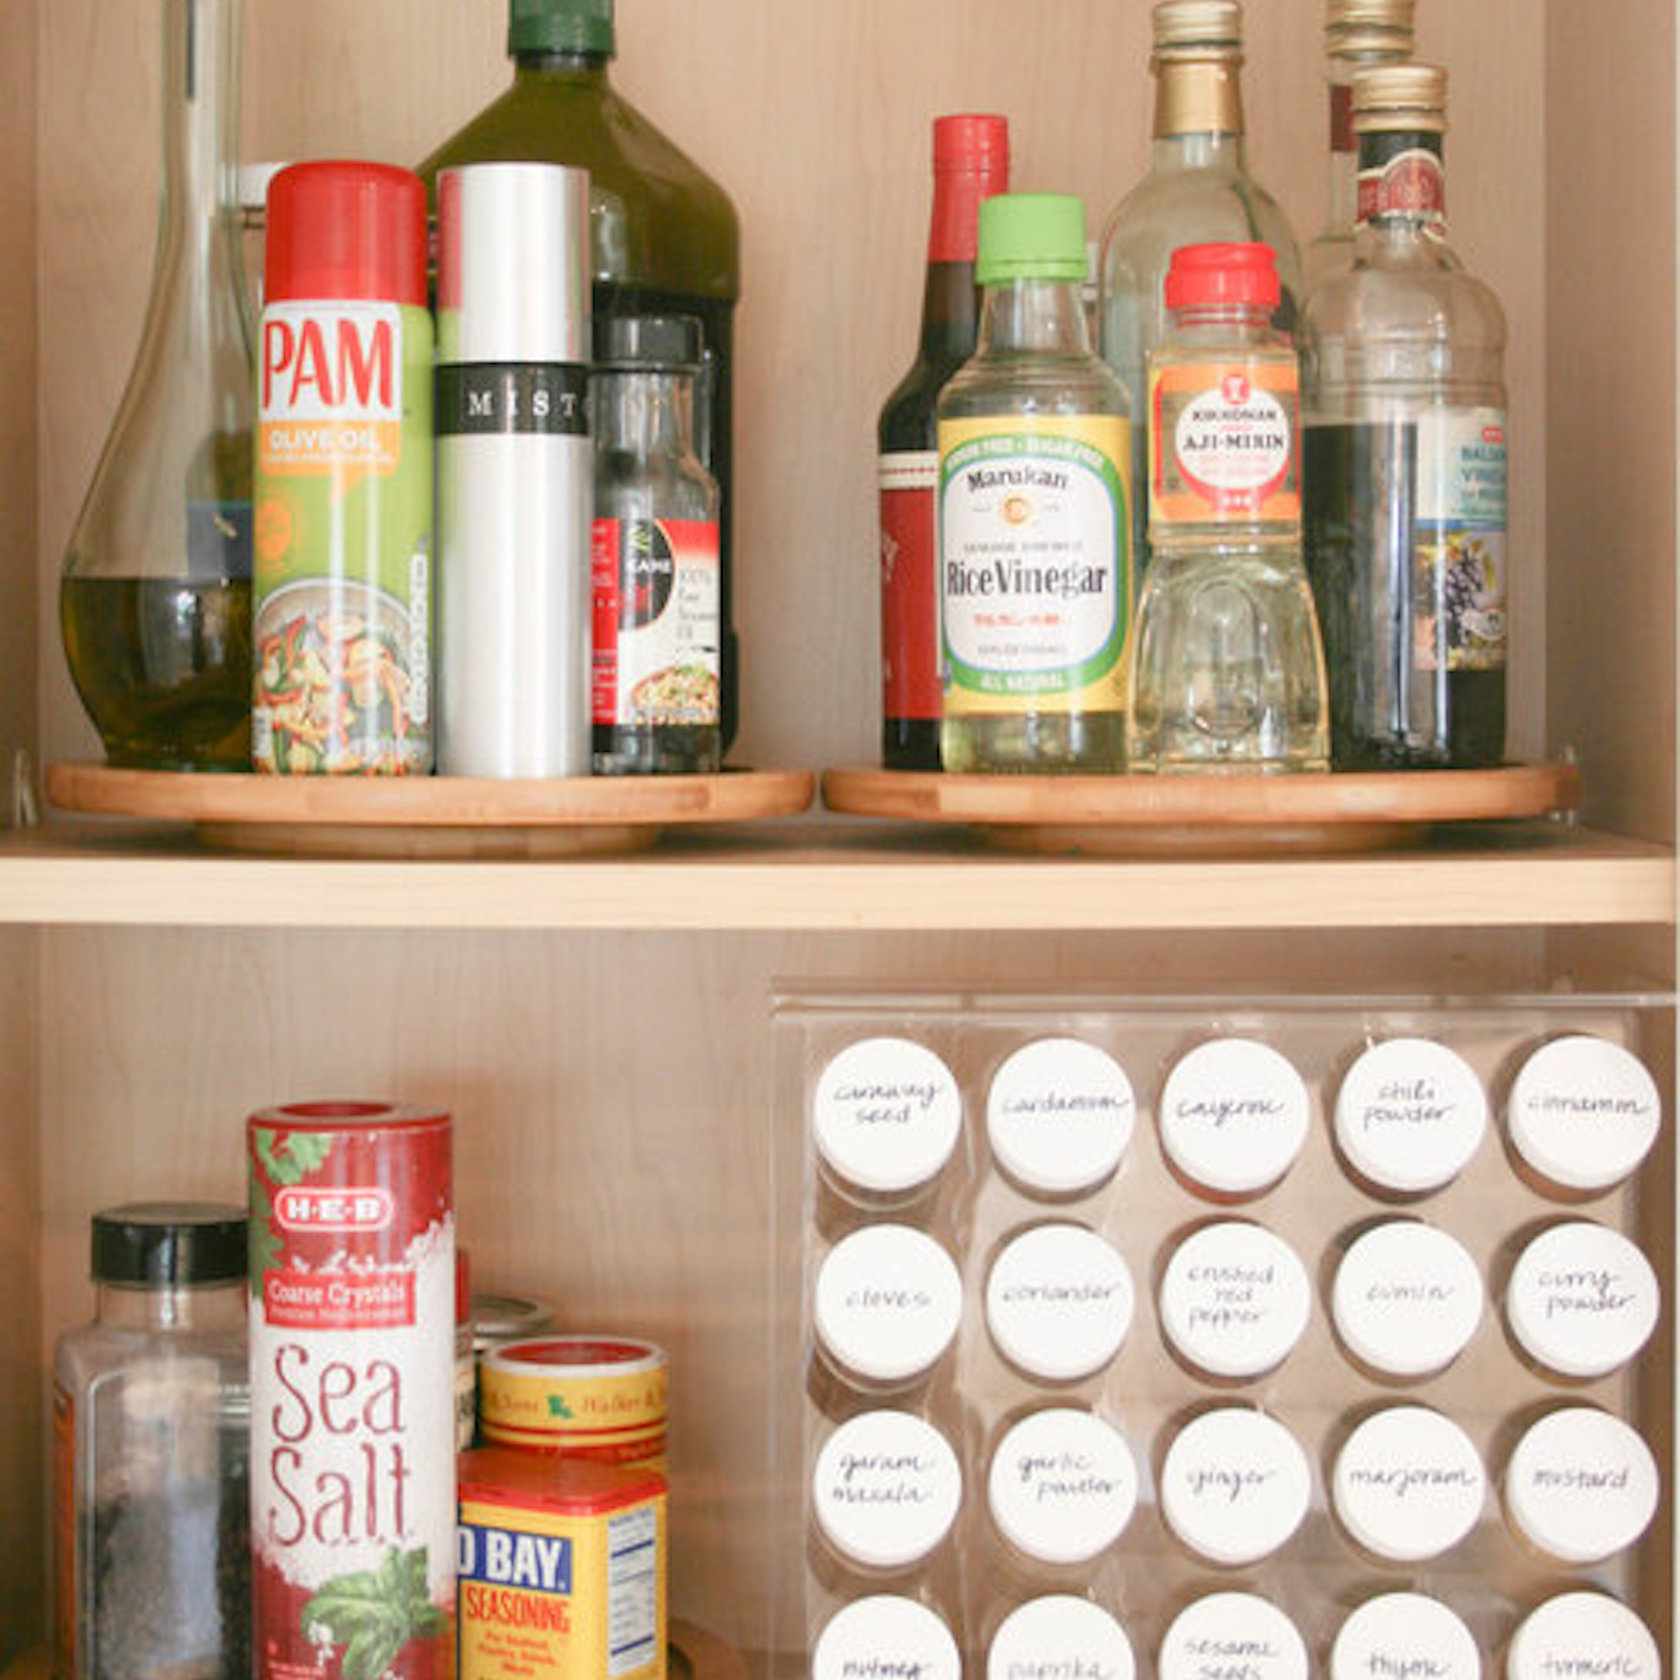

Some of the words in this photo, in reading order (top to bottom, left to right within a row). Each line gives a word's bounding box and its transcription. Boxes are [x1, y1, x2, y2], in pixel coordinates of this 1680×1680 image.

[263, 317, 393, 412] PAM
[271, 429, 330, 450] OLIVE
[335, 429, 381, 450] OIL
[1183, 433, 1284, 450] AJI-MIRIN
[966, 464, 1070, 492] Marukan
[947, 560, 993, 597] Rice
[994, 558, 1107, 600] Vinegar
[269, 1280, 323, 1303] Coarse
[272, 1344, 405, 1443] Sea
[269, 1442, 411, 1547] Salt
[467, 1586, 571, 1634] SEASONING
